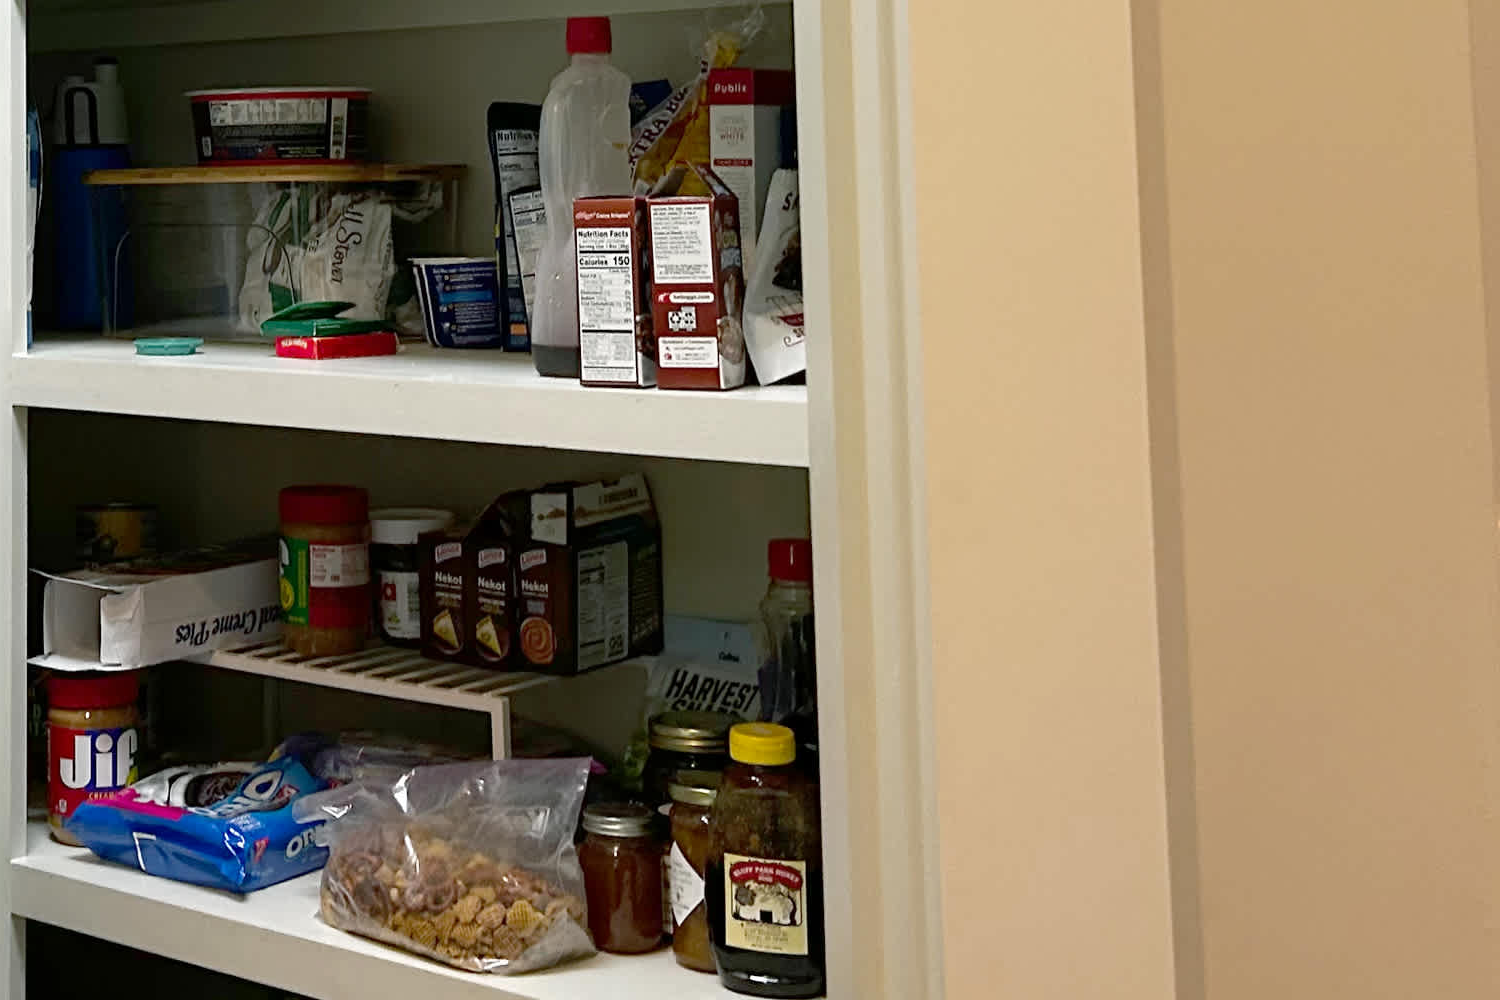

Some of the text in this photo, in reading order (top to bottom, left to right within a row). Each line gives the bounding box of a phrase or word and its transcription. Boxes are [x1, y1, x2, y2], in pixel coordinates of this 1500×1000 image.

[713, 81, 748, 94] Publix
[609, 230, 629, 238] Facts
[331, 218, 363, 285] Stover
[579, 256, 630, 266] Calories 150
[435, 570, 463, 585] Nekot
[477, 575, 506, 592] Nekot
[521, 578, 549, 593] Nekot
[212, 608, 257, 635] Creme
[175, 621, 210, 647] Pies
[665, 668, 760, 713] HARVEST
[59, 727, 139, 790] Jif
